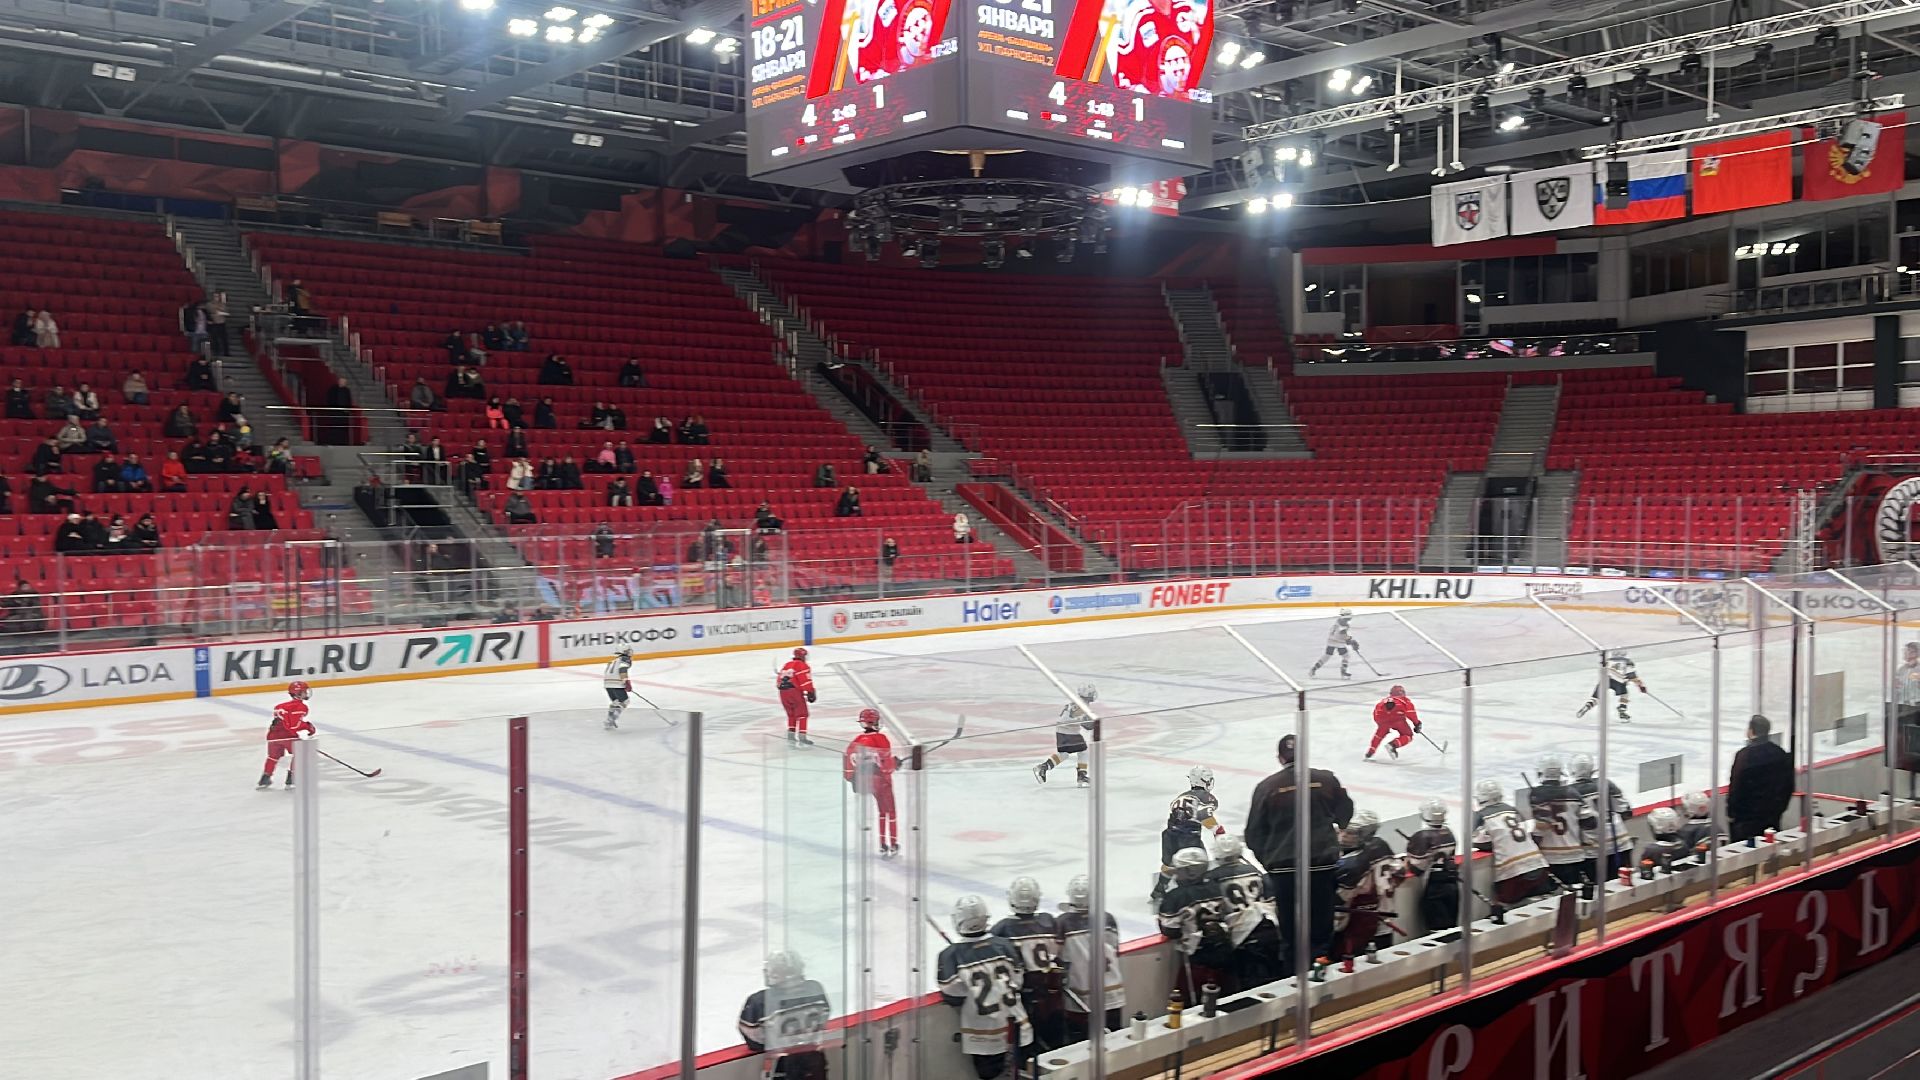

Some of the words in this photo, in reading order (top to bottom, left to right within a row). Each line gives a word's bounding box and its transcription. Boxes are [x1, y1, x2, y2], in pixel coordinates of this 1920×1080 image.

[751, 15, 804, 60] 18-21
[978, 5, 1054, 38] ЯНВАРЯ
[751, 50, 806, 82] ЯНВАРЯ
[801, 104, 817, 126] 4
[872, 84, 885, 109] 1
[1049, 81, 1067, 105] 4
[1131, 98, 1144, 121] 1
[1149, 583, 1231, 608] FONBET
[1368, 578, 1474, 599] KHL.RU
[963, 598, 1021, 623] Haier
[559, 627, 678, 649] ТИНЬКОФФ
[81, 663, 173, 688] LADA
[223, 641, 374, 681] KHL.RU
[971, 964, 1018, 1016] 23
